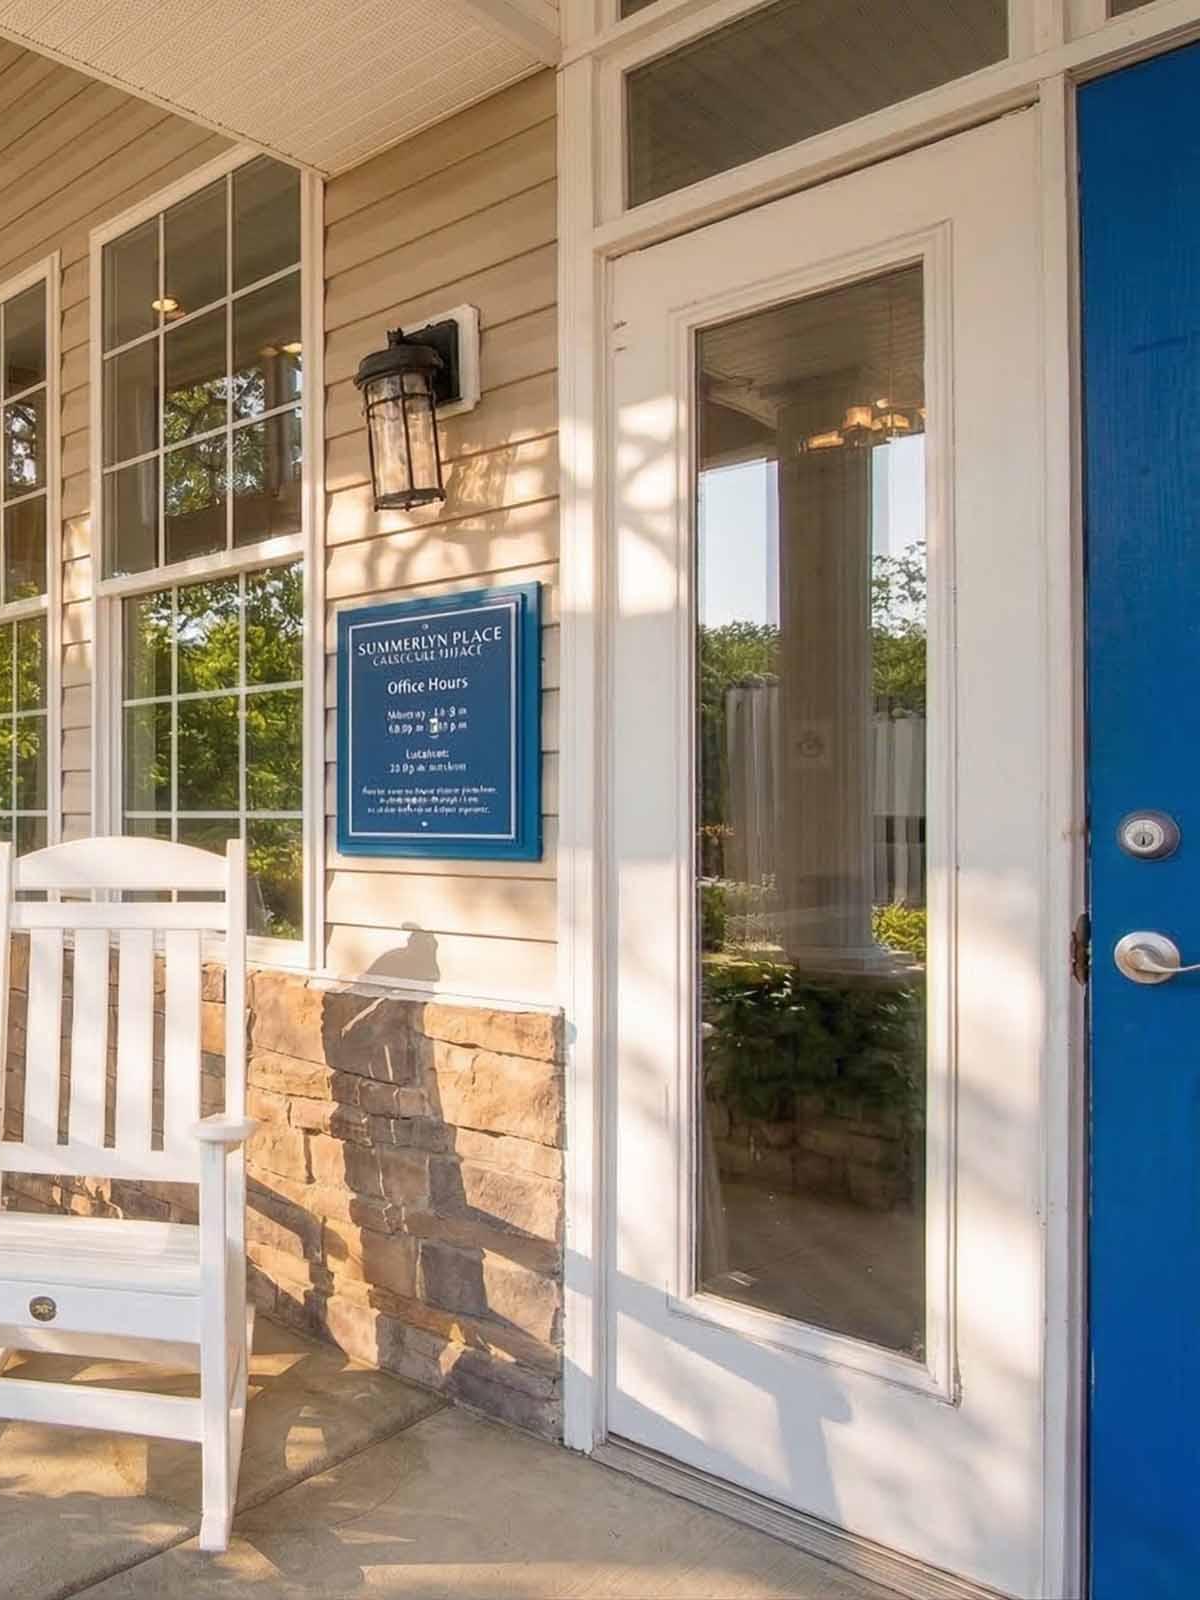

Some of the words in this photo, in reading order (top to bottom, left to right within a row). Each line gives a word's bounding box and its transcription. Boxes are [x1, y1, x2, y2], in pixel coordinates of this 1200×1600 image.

[358, 633, 448, 656] SUMMERLYN
[452, 626, 503, 645] PLACE
[387, 680, 425, 695] Office
[428, 677, 468, 691] Hours
